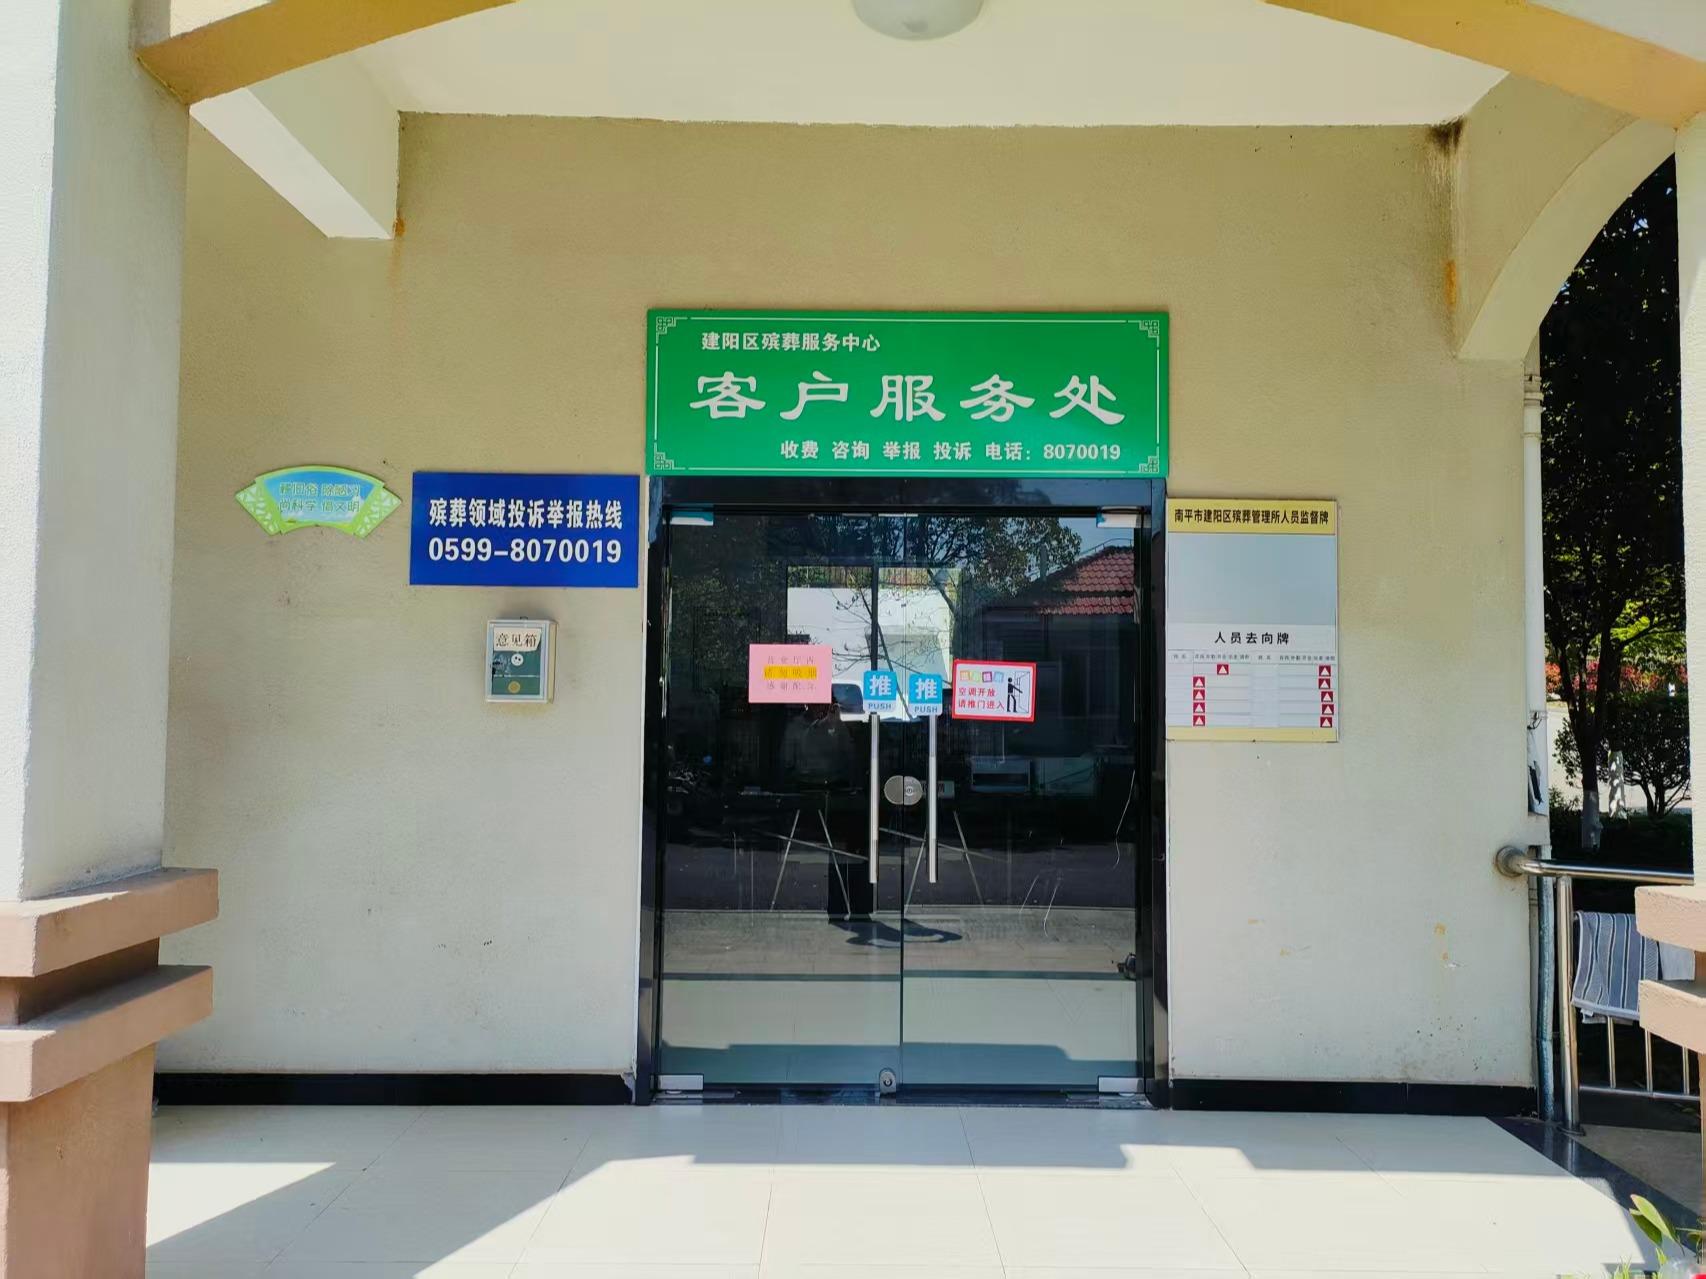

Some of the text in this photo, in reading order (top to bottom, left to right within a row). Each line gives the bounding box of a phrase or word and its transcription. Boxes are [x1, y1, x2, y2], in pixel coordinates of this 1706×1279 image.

[701, 332, 881, 353] 建阳区殡葬服务中心
[689, 370, 1125, 425] 客户服务处
[780, 441, 819, 460] 收费
[832, 441, 870, 460] 咨询
[883, 442, 921, 460] 举报
[933, 442, 972, 460] 投诉
[429, 497, 623, 530] 殡葬领域投诉举报热线
[1174, 508, 1329, 525] 南平市建阳区殡葬管理所人员监督牌
[428, 537, 622, 563] 0599-8070019
[496, 632, 538, 648] 意见箱
[1214, 631, 1290, 645] 人员去向牌
[869, 675, 892, 696] 推
[915, 678, 939, 700] 推
[958, 687, 996, 697] 空调开放
[868, 702, 892, 710] PUSH
[914, 705, 938, 713] PUSH
[958, 699, 1005, 710] 请推门进入
